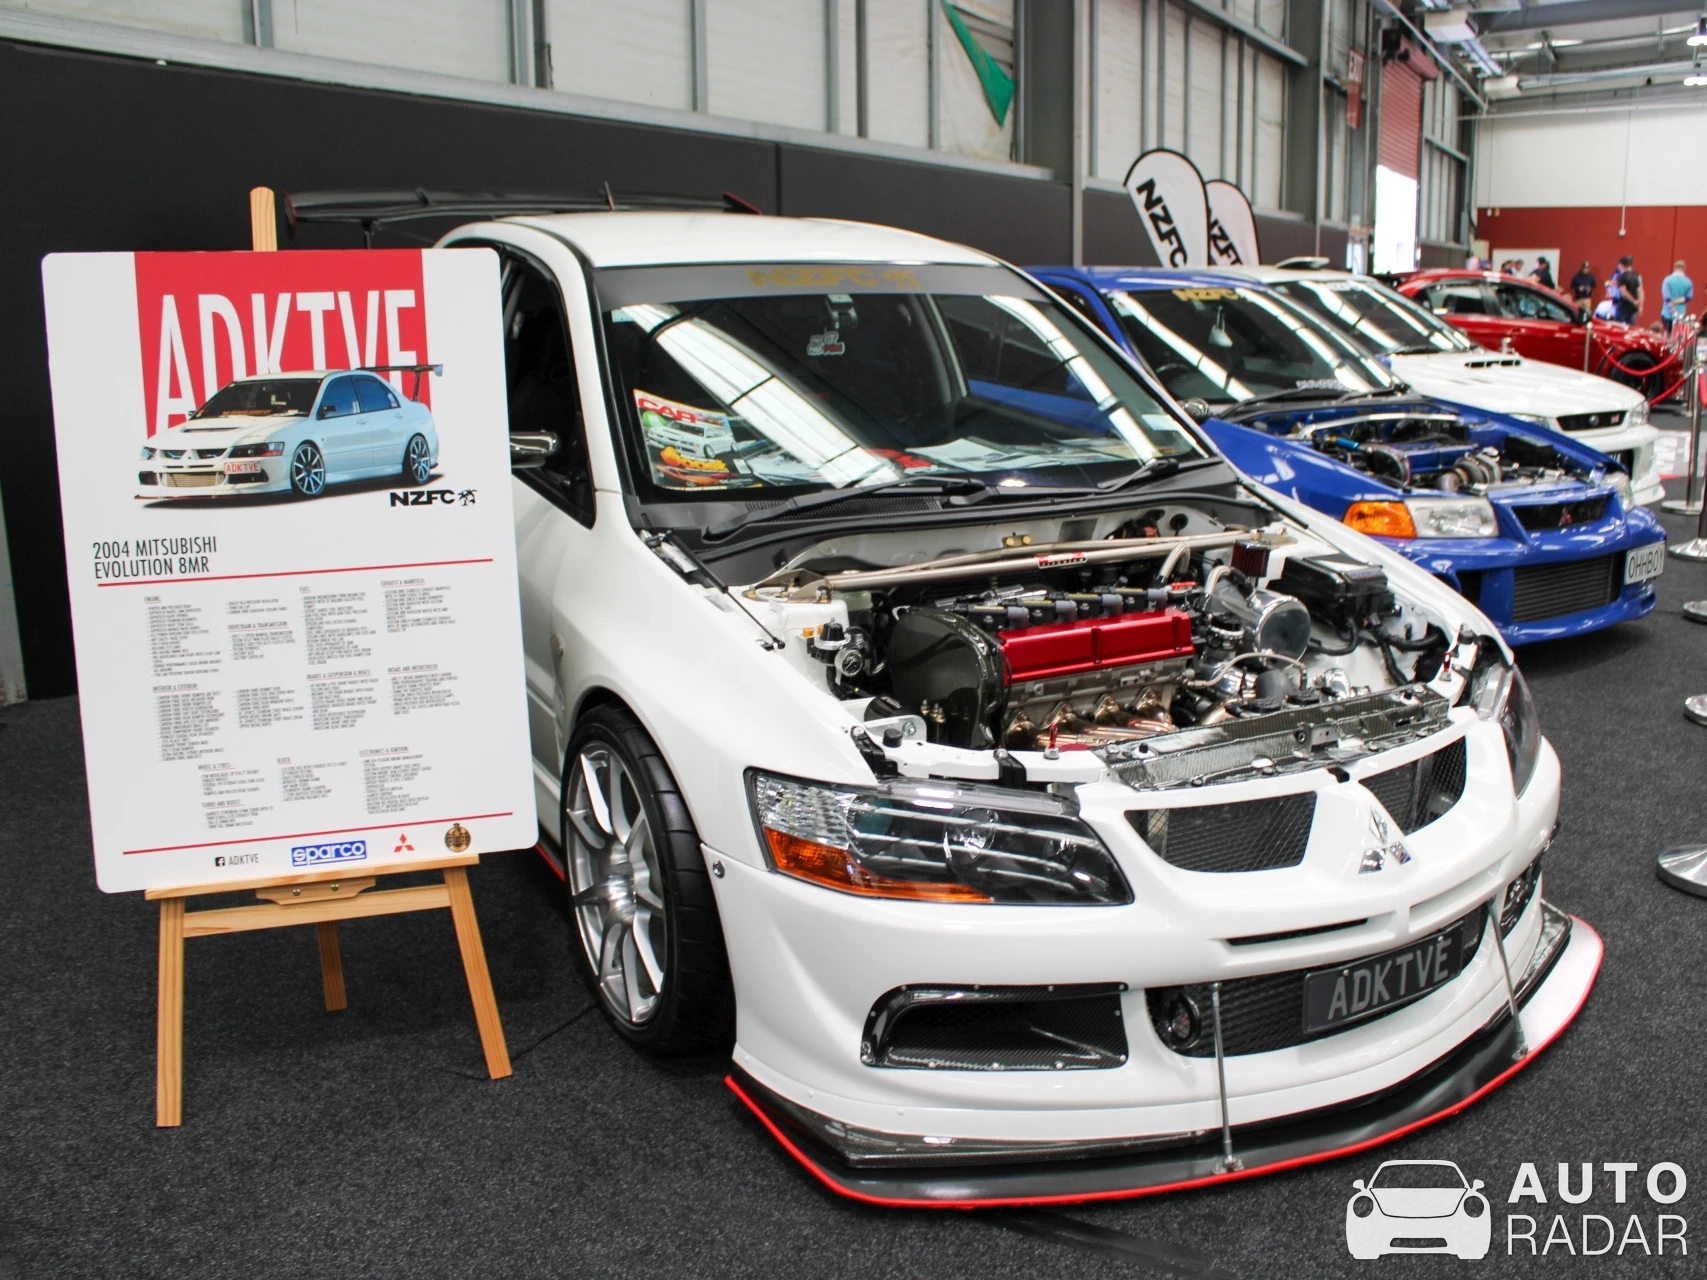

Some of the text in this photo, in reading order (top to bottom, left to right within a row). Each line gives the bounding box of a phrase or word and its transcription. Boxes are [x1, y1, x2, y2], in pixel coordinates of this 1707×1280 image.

[1136, 177, 1188, 268] NZFC
[744, 267, 880, 288] NZFC
[638, 397, 696, 423] CAR
[226, 462, 259, 473] ADKTVE
[389, 489, 455, 507] NZFC
[93, 536, 217, 559] 2004 MITSUBISHI
[94, 556, 210, 579] EVOLUTION 8MR
[1629, 545, 1664, 579] OHHBOY
[228, 853, 259, 866] ADKTVE
[293, 842, 365, 865] sparco
[1328, 937, 1451, 1020] ADKTVE
